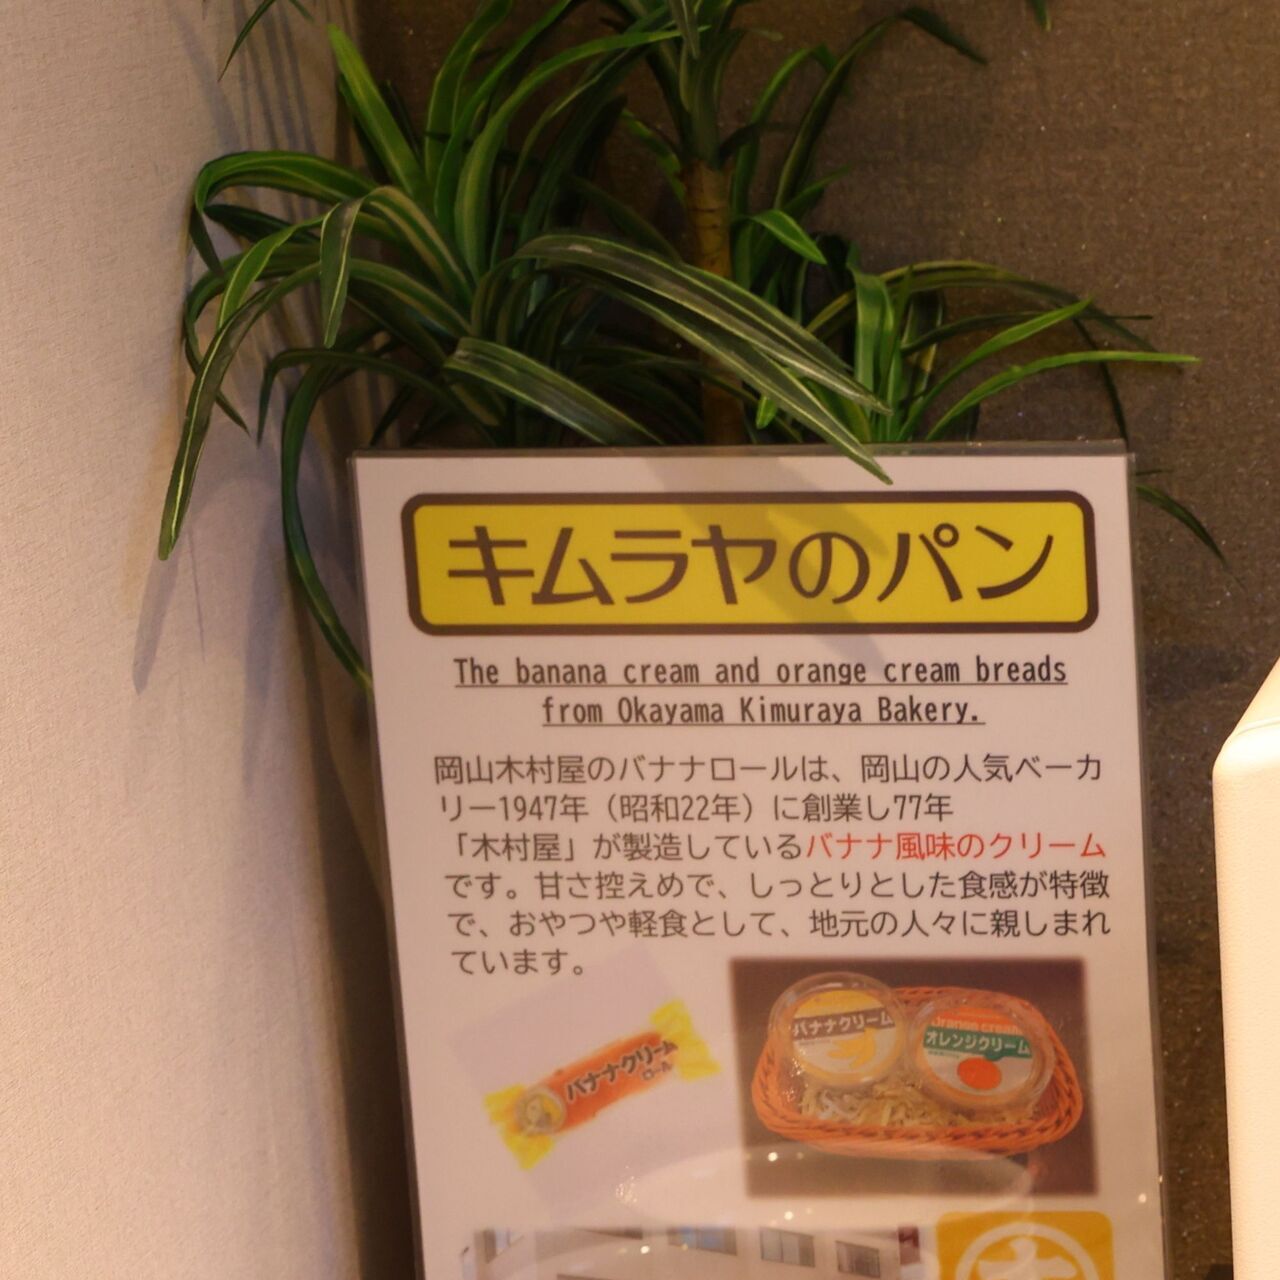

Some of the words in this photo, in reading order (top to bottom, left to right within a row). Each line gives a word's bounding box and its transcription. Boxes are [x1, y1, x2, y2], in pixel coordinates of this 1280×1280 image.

[448, 522, 1054, 606] キムラヤのパン
[454, 658, 500, 684] The
[516, 658, 606, 684] banana
[623, 662, 699, 684] cream
[715, 658, 759, 683] and
[777, 661, 867, 688] orange
[884, 661, 961, 682] cream
[976, 656, 1067, 681] breads
[542, 696, 603, 724] from
[617, 696, 724, 725] Okayama
[740, 696, 862, 725] Kimuraya
[878, 695, 981, 724] Bakery.
[445, 870, 1109, 902] です。甘さ控えめで、しっとりとした食感が特徴
[448, 908, 1111, 938] で、おやつや軽食として、地元の人々に親しまれ
[451, 947, 587, 977] ています。
